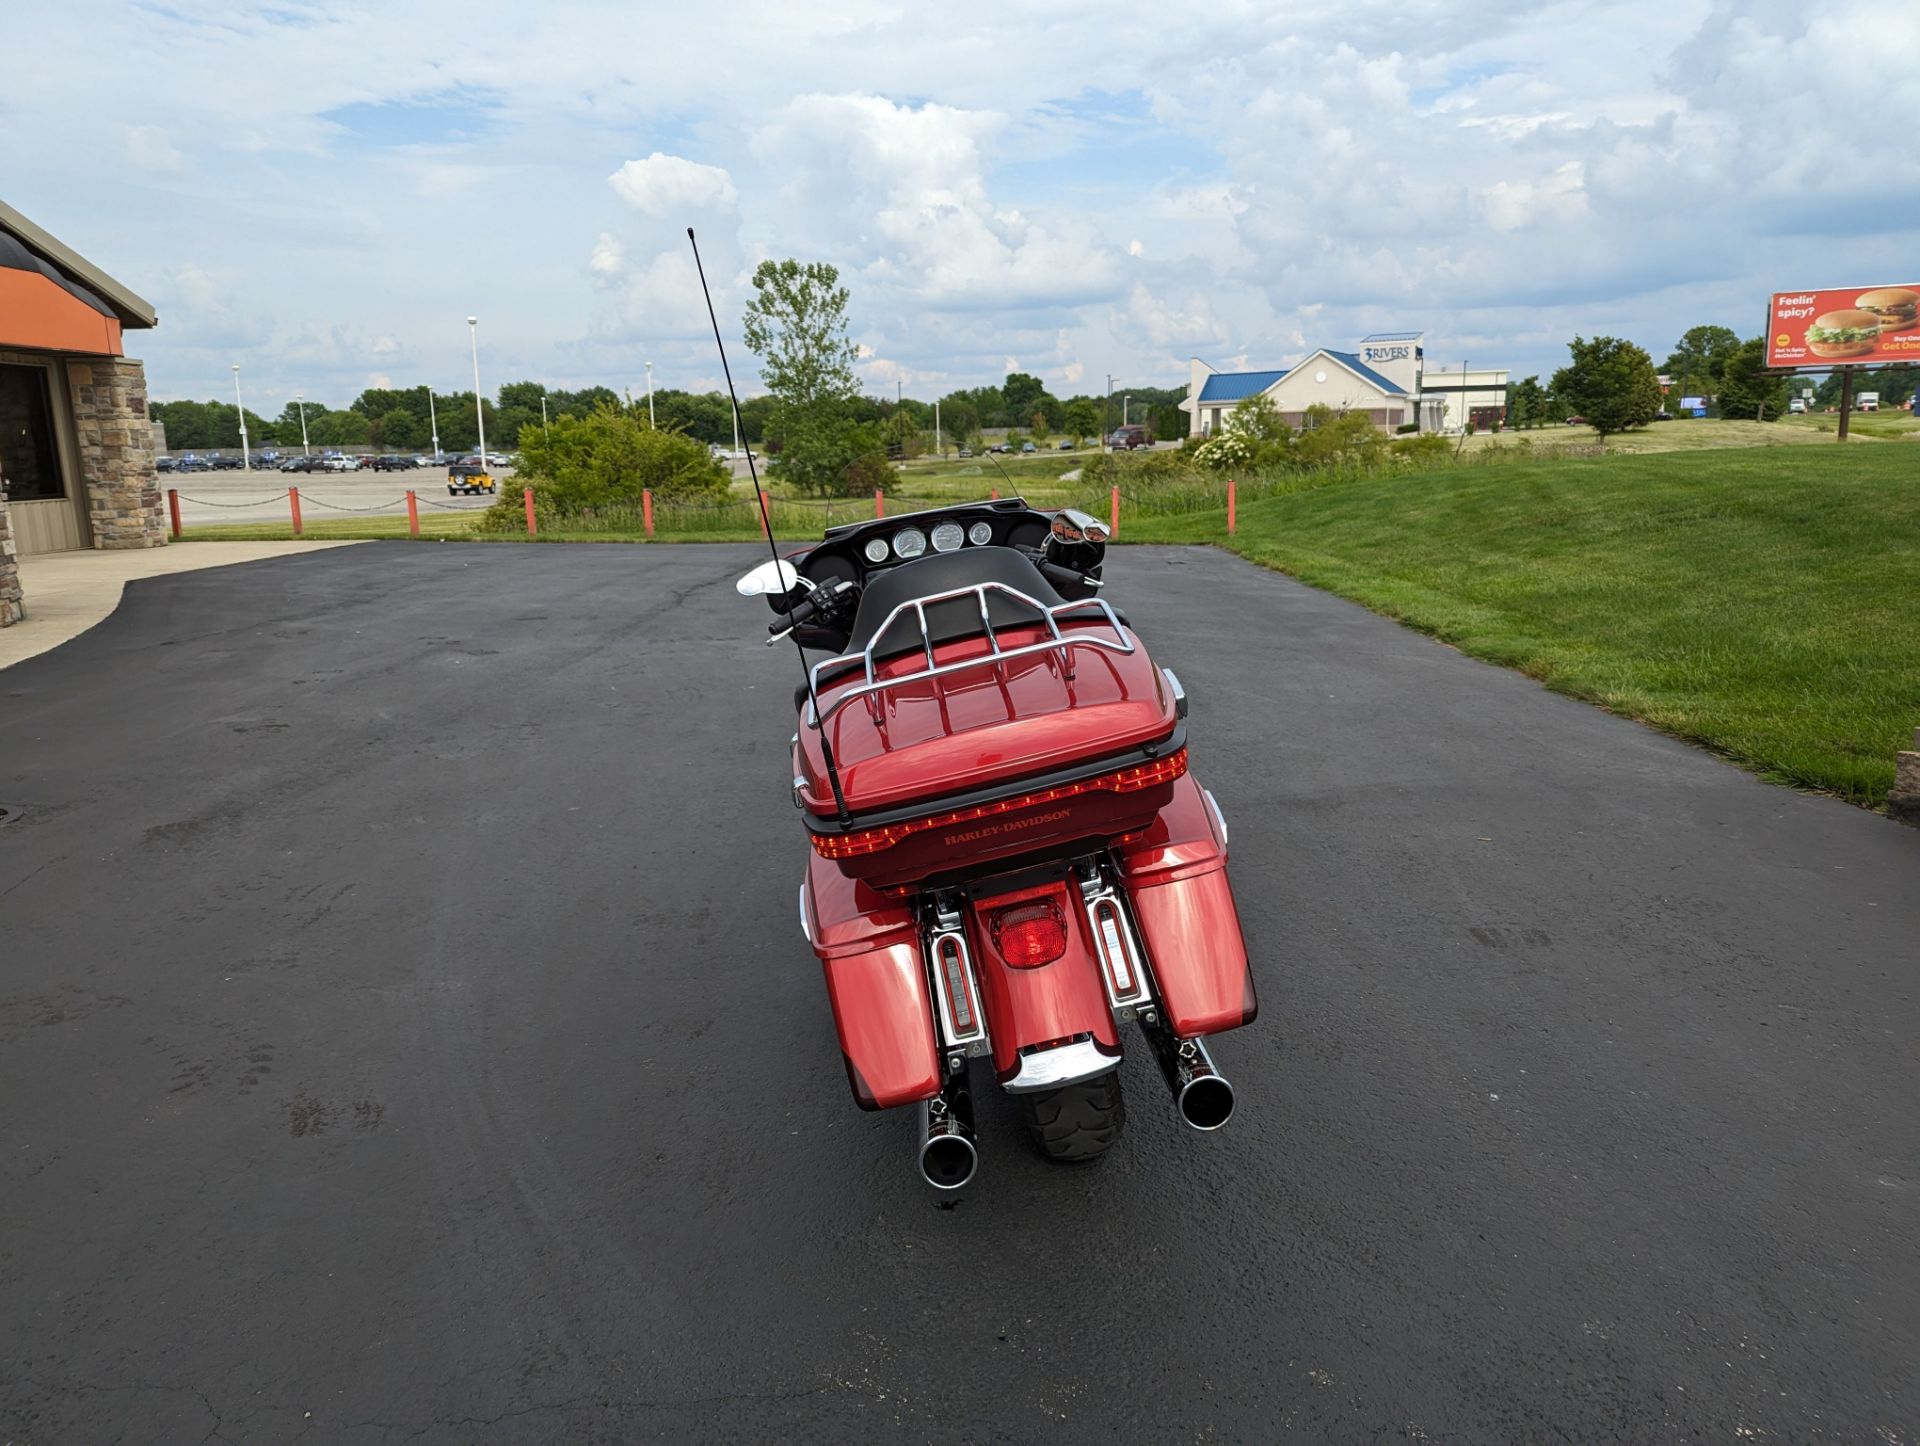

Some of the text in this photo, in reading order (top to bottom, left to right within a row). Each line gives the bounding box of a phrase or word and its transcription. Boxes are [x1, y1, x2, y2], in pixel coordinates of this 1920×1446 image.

[1779, 295, 1816, 305] Feelin'
[1778, 307, 1815, 318] spicy?
[1882, 342, 1900, 350] Get
[1373, 347, 1408, 358] RIVERS
[944, 809, 1071, 845] HARLEY-DAVIDSON
